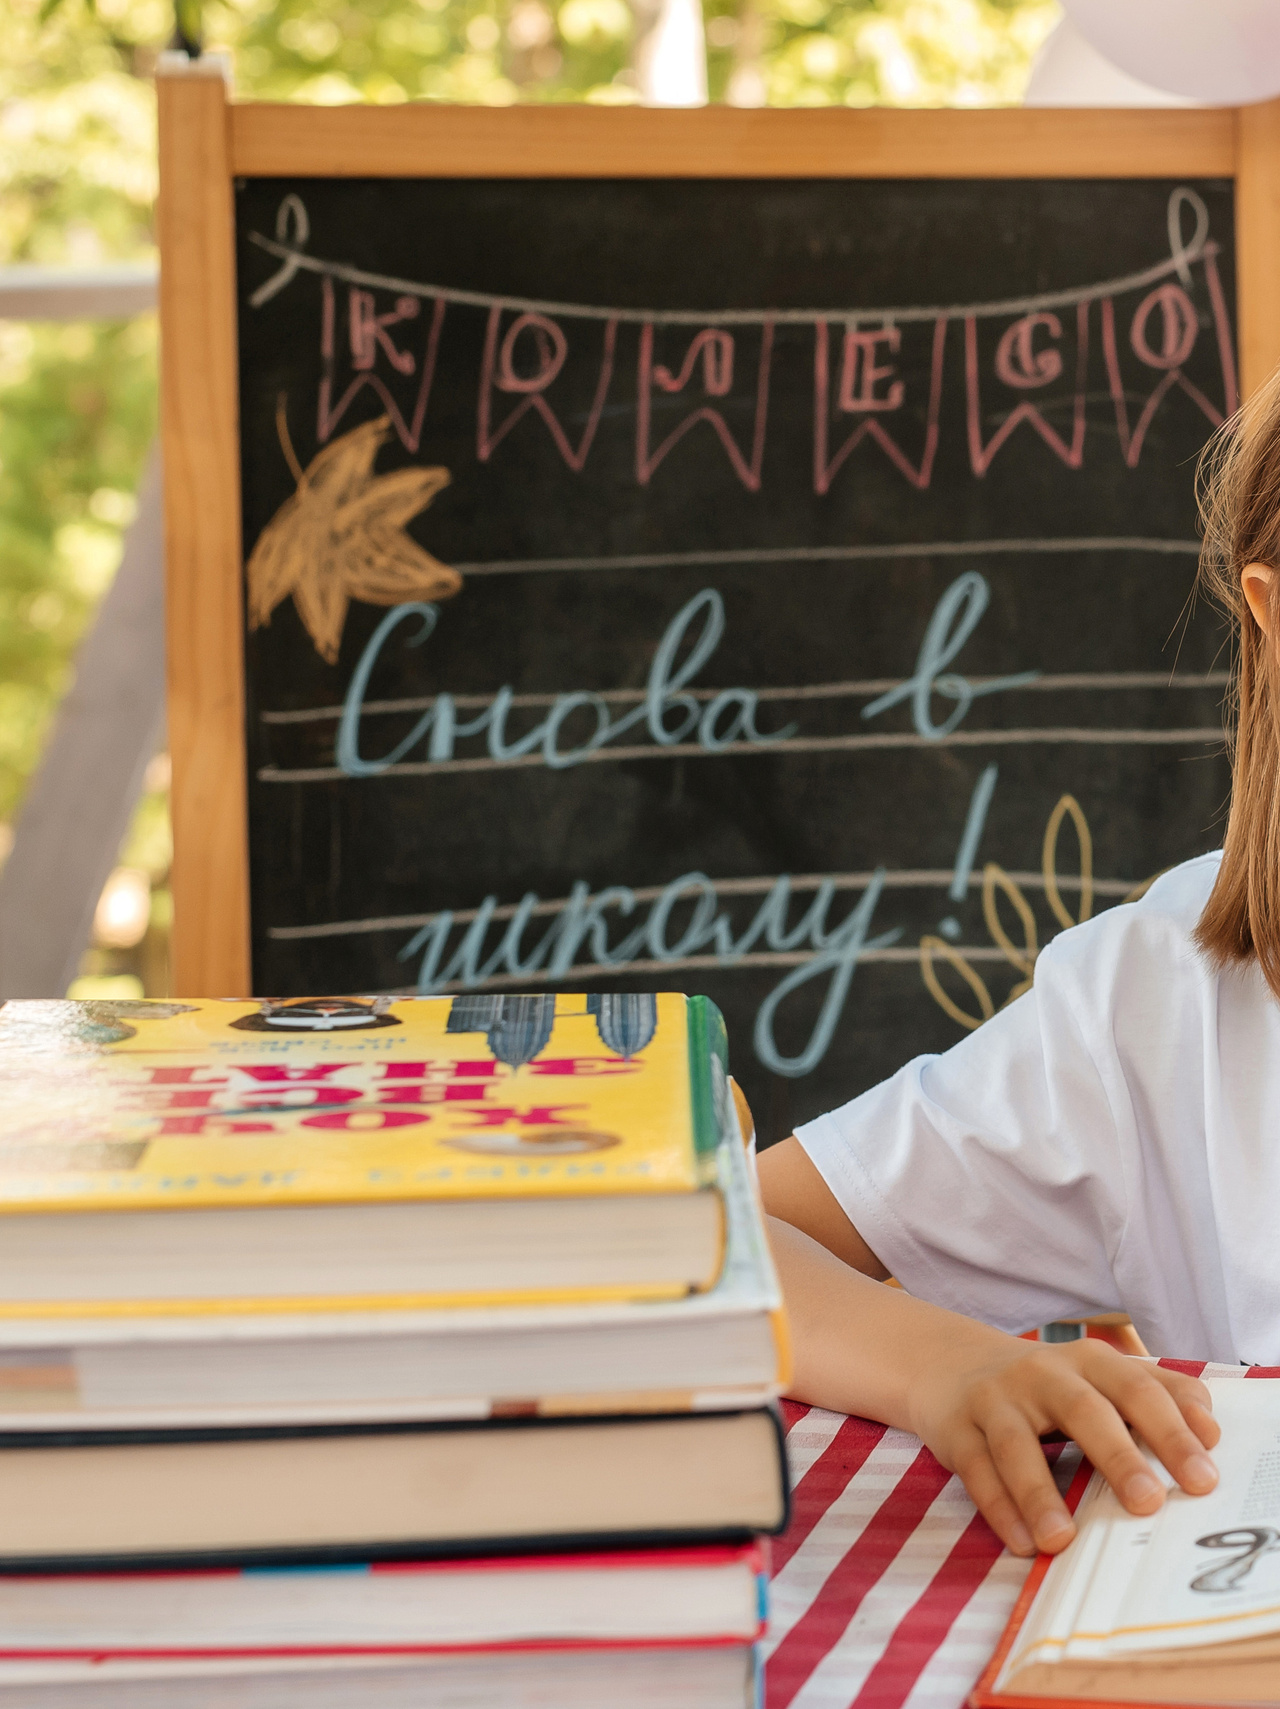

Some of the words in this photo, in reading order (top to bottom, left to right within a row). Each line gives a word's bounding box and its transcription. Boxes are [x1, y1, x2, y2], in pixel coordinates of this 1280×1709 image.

[349, 284, 1198, 412] КОЛЕСО
[335, 587, 797, 777] Снова
[862, 570, 1040, 741] в
